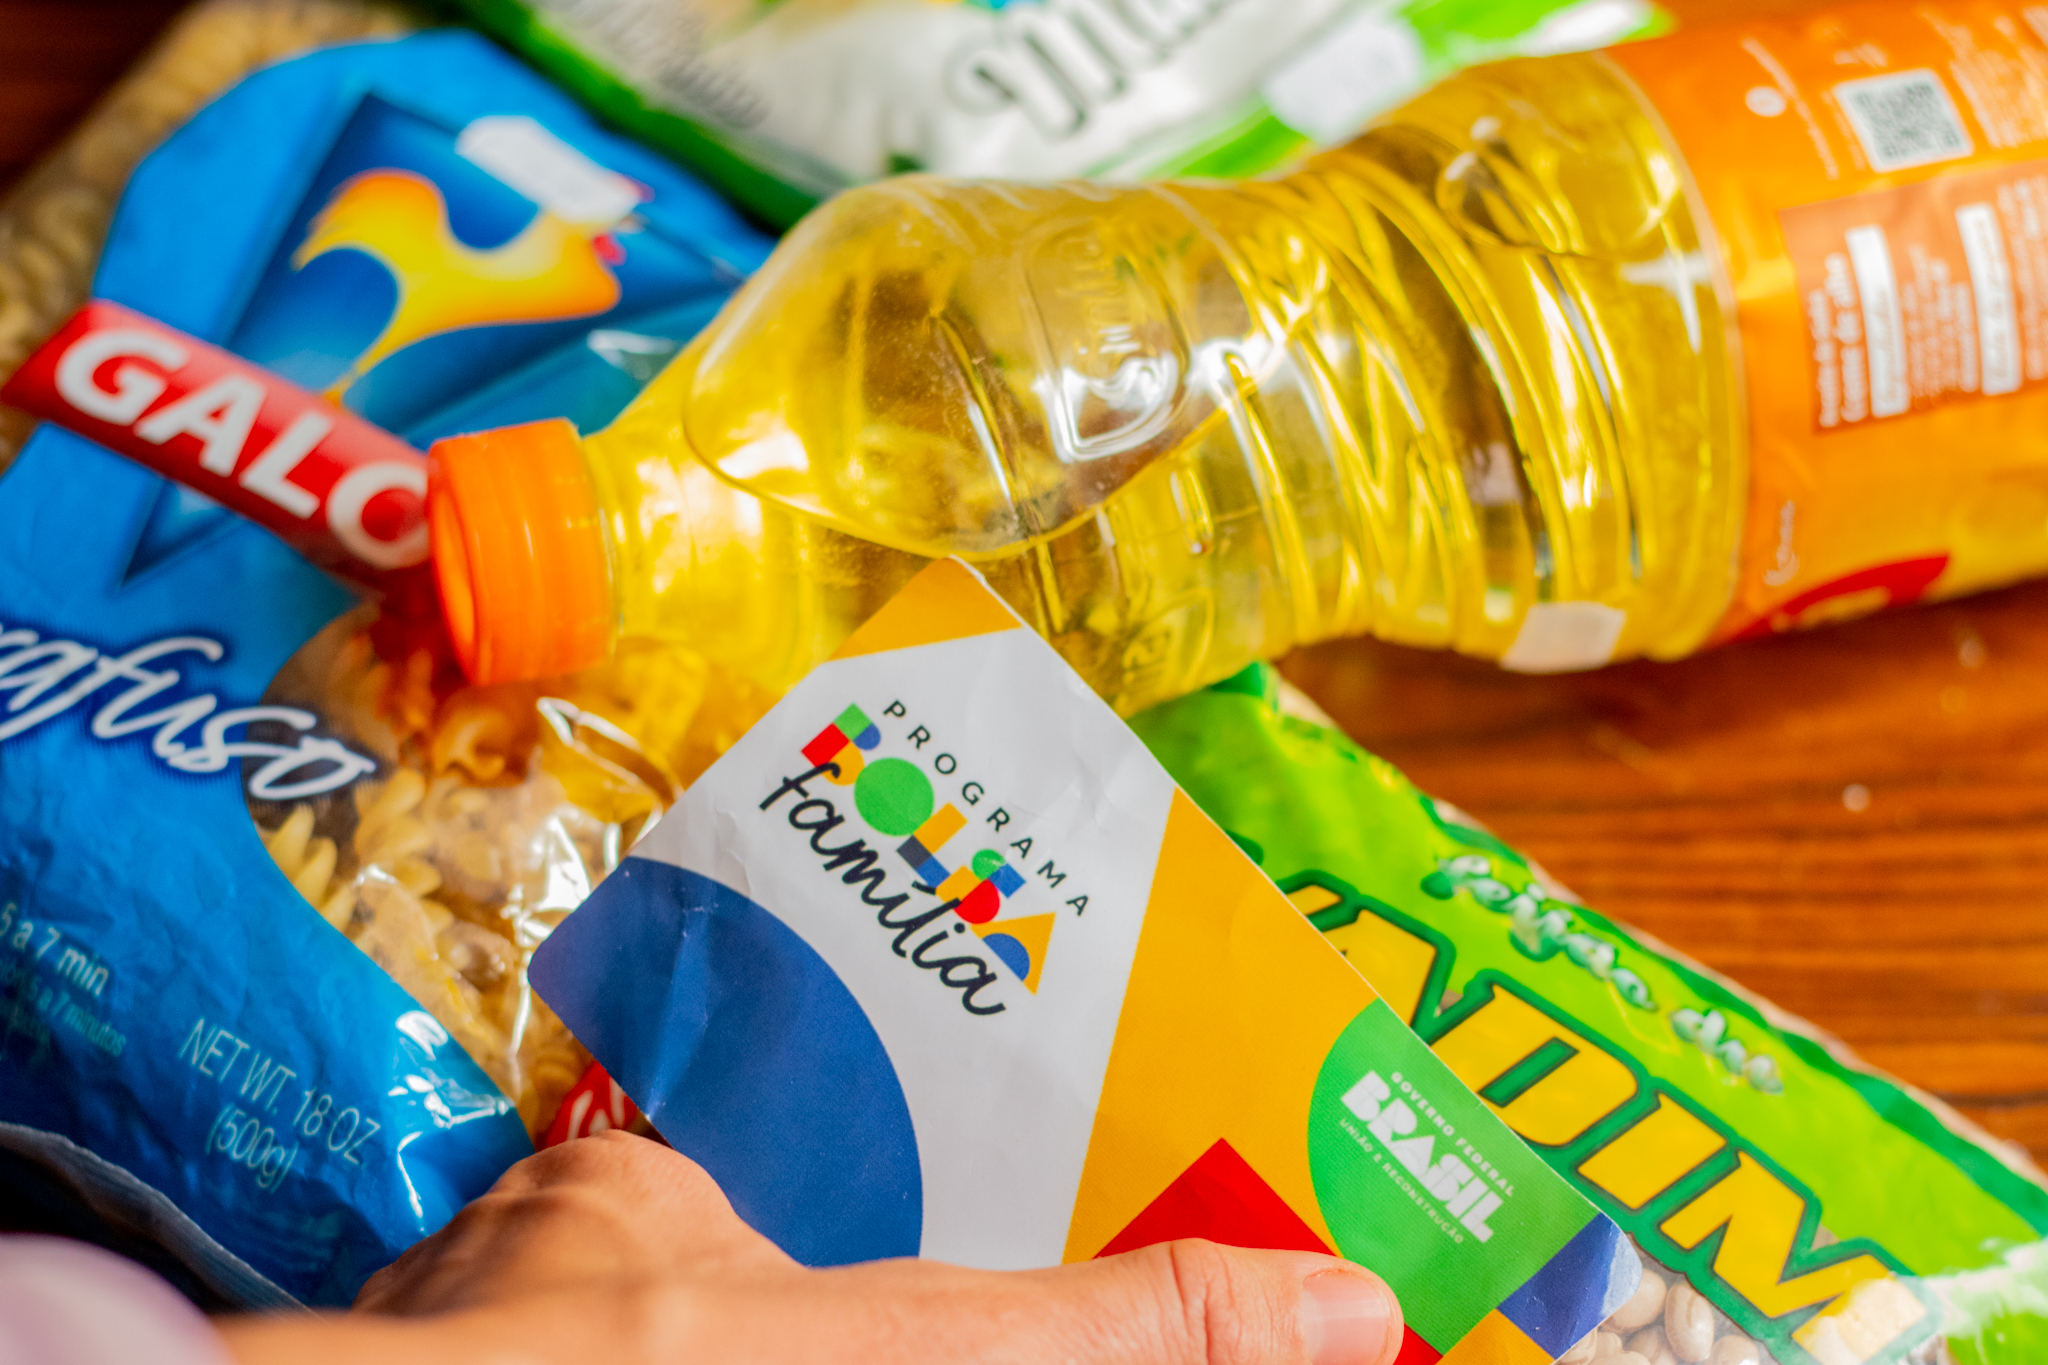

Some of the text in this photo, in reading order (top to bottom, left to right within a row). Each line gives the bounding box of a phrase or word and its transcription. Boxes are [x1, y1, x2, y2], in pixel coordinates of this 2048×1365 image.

[55, 329, 431, 570] GALO
[882, 700, 1089, 916] PROGRAMA
[12, 921, 36, 951] a
[36, 927, 62, 961] 7
[57, 942, 110, 996] min
[758, 762, 1007, 1016] família
[178, 1018, 381, 1165] NET WT. 18 OZ
[205, 1104, 299, 1194] (500g)
[1340, 1070, 1504, 1243] BRASIL
[1391, 1071, 1515, 1198] GOVERNO FEDERAL
[1339, 1118, 1374, 1154] UNIÃO
[1382, 1162, 1465, 1245] RECONSTRUÇÃO
